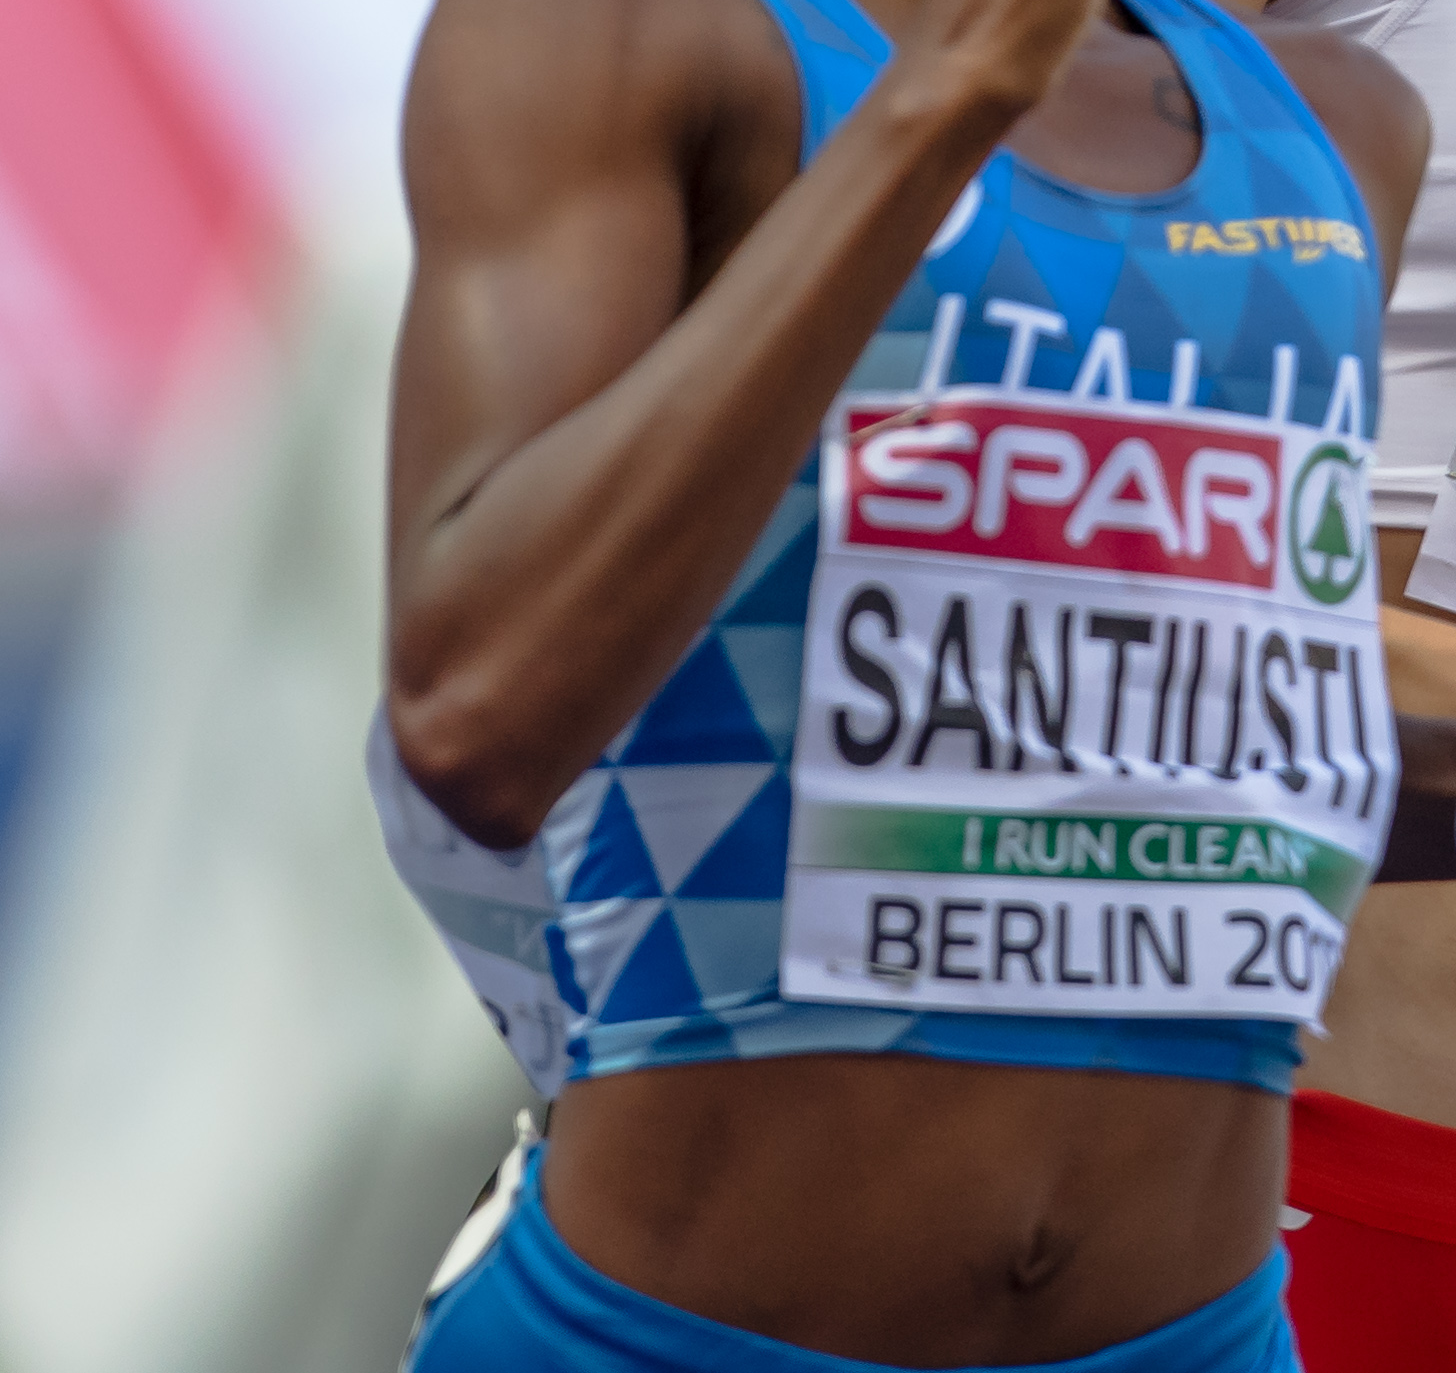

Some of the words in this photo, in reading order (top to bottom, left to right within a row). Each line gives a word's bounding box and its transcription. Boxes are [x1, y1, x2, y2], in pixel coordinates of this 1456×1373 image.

[857, 421, 1271, 568] SPAR
[831, 585, 1379, 820] SANTIUSTI
[961, 817, 984, 870] I
[994, 818, 1116, 873] RUN
[1128, 824, 1309, 880] CLEAN
[867, 896, 1190, 989] BERLIN
